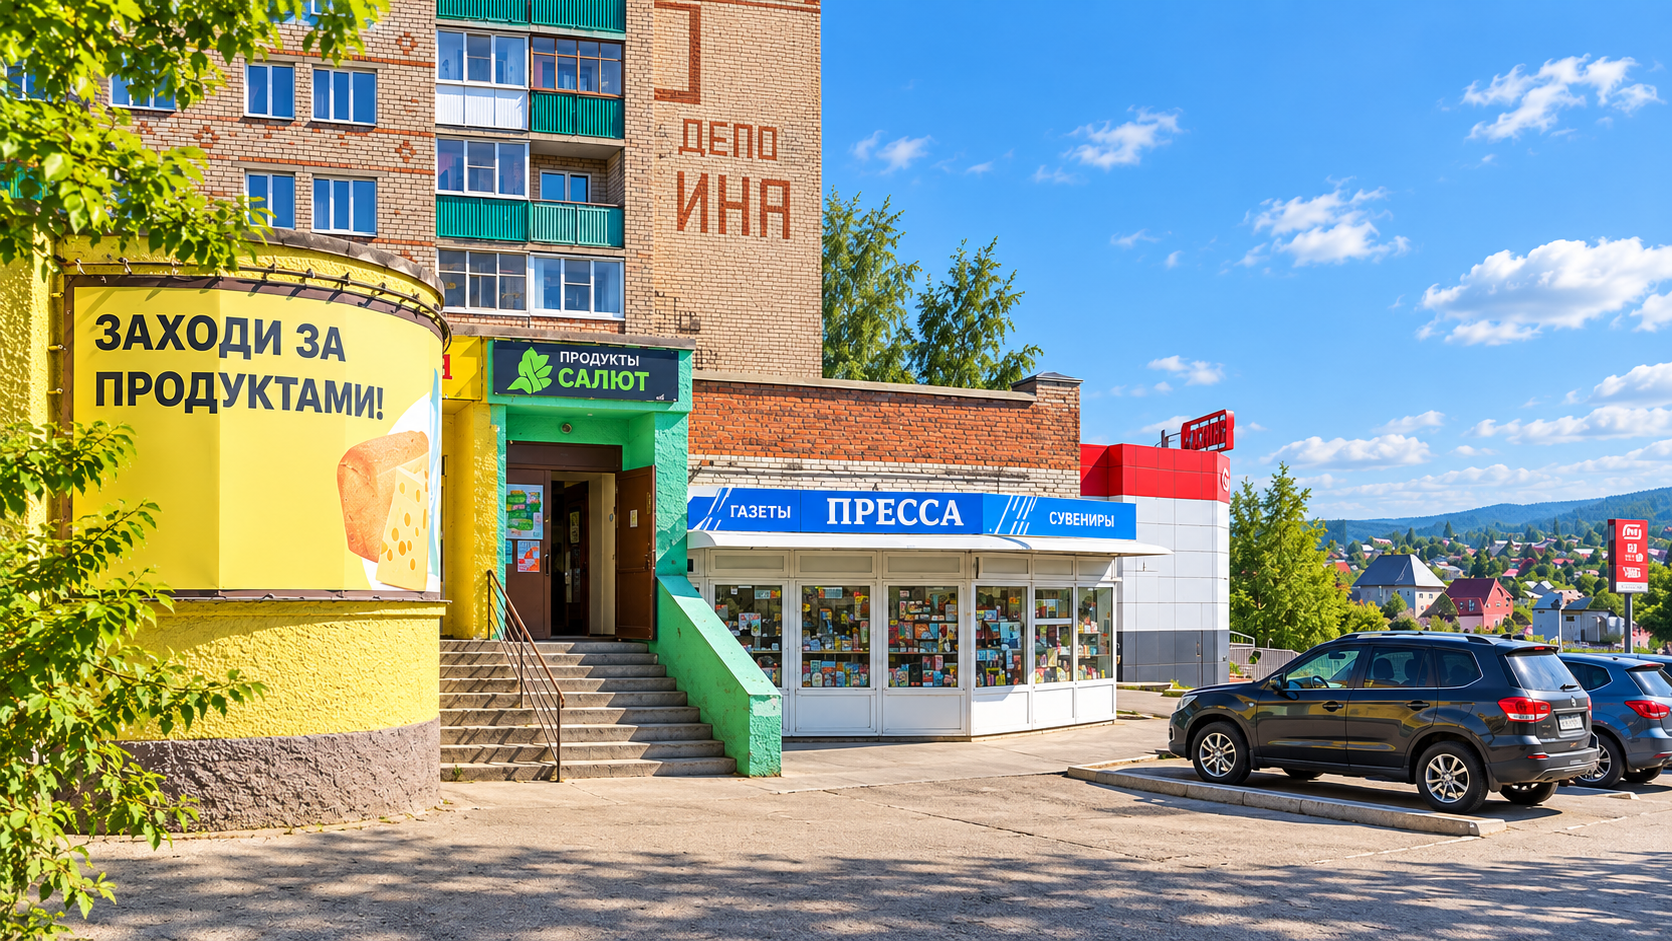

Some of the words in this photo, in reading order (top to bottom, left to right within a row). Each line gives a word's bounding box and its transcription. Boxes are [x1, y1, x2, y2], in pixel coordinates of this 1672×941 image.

[678, 118, 778, 161] ДЕПО
[677, 170, 790, 240] ИНА
[94, 313, 282, 360] ЗАХОДИ
[295, 322, 347, 362] ЗА
[559, 351, 640, 367] ПРОДУКТЫ
[558, 368, 650, 392] САЛЮТ
[95, 370, 385, 421] ПРОДУКТАМИ!
[729, 503, 792, 520] ГАЗЕТЫ
[826, 497, 964, 527] ПРЕССА
[1048, 510, 1115, 529] СУВЕНИРЫ
